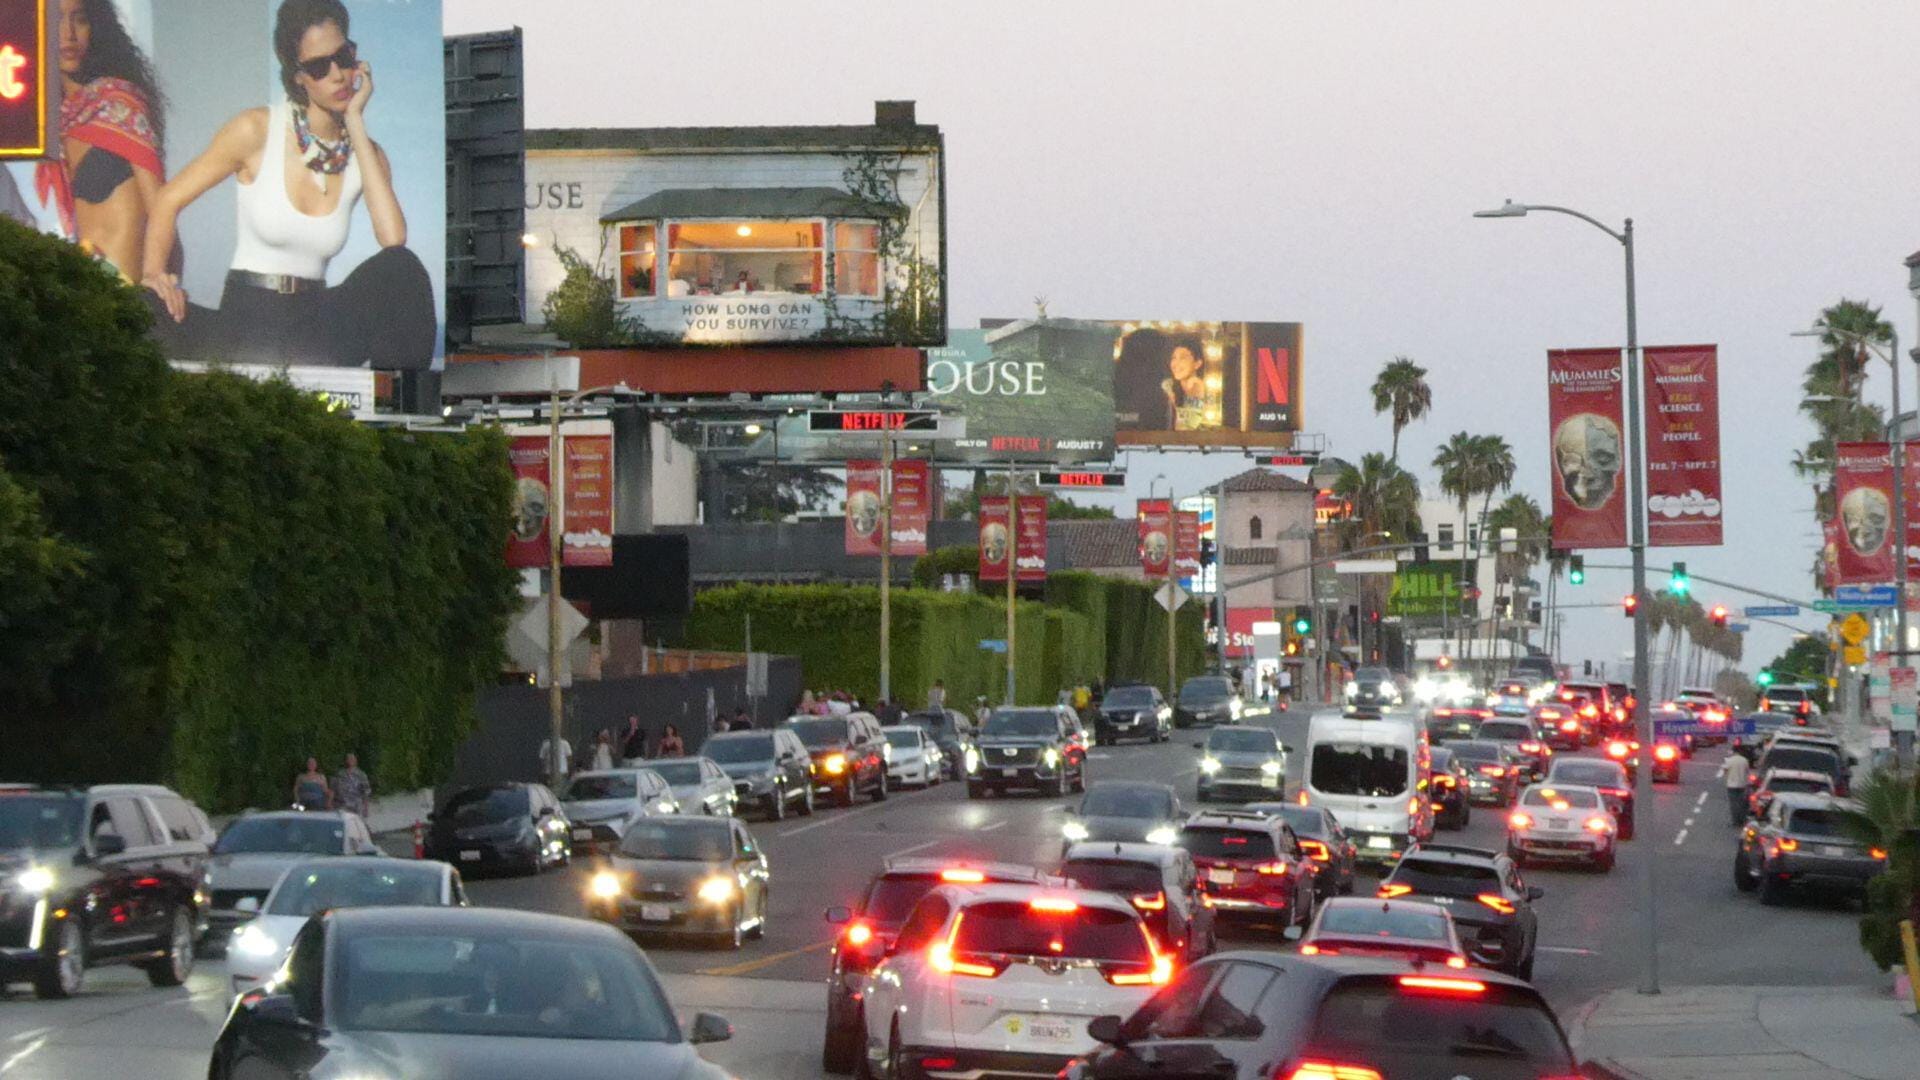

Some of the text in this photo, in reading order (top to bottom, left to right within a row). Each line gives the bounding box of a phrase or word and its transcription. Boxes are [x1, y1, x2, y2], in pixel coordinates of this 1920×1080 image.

[682, 303, 812, 315] HOW LONG CAN
[686, 318, 809, 330] YOU SURVIVE?
[1257, 347, 1288, 404] N
[1550, 367, 1621, 384] MUMMIES
[991, 436, 1040, 451] NETFLIX
[1057, 441, 1094, 450] AUGUST
[1096, 441, 1104, 450] 7
[1059, 473, 1104, 487] NETFLIX
